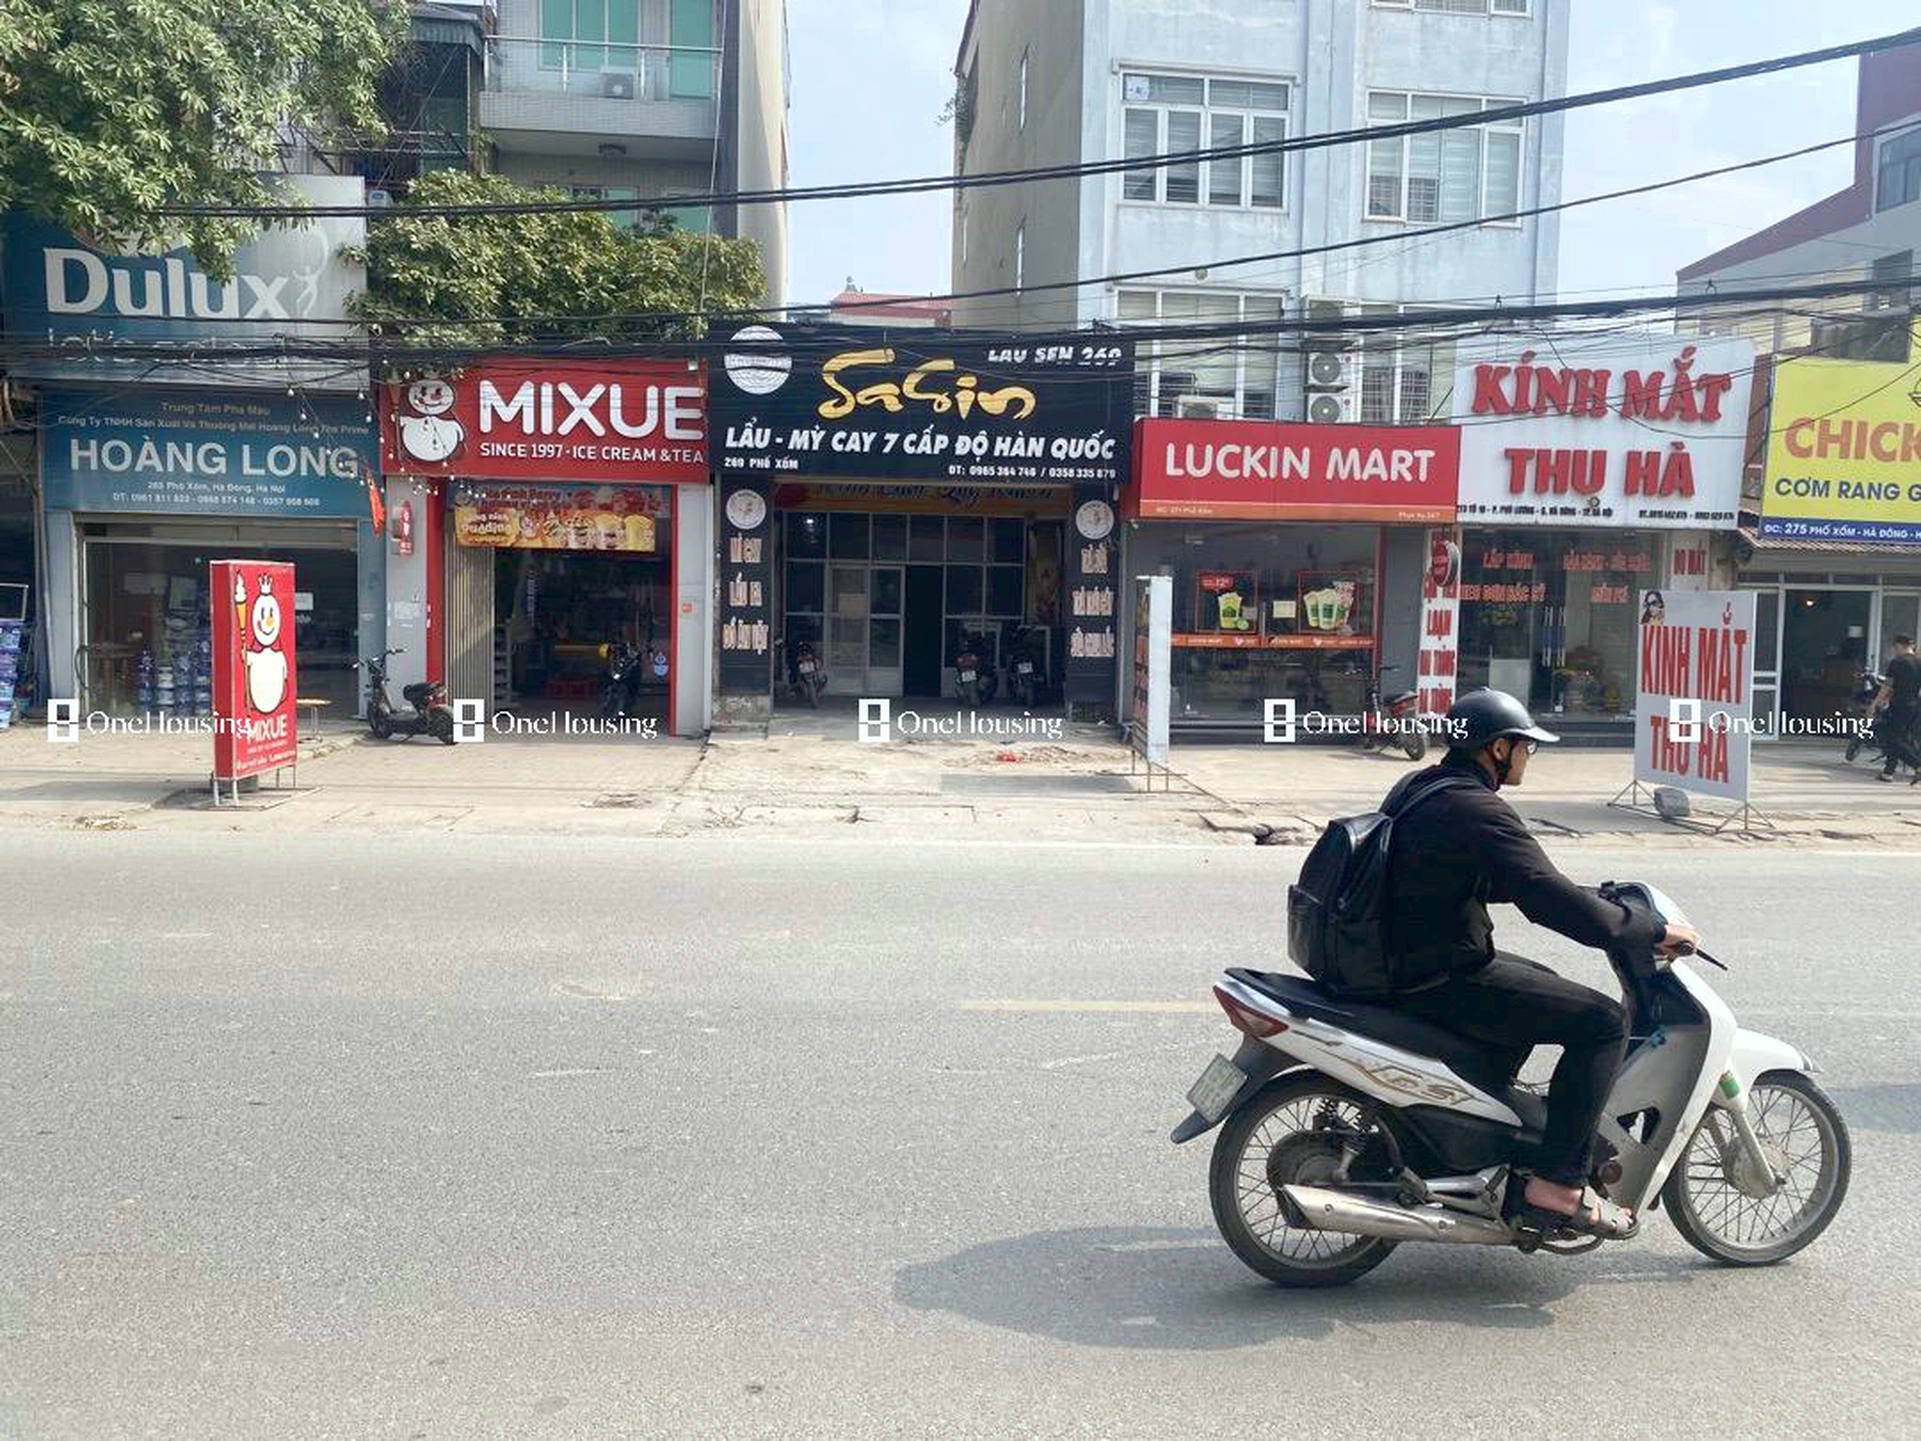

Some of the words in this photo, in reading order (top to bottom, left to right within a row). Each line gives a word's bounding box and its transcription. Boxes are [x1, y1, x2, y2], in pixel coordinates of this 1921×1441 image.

[44, 247, 290, 318] Dulux
[1471, 350, 1610, 417] KÍNH
[1620, 345, 1732, 423] MẮT
[479, 379, 704, 440] MIXUE
[70, 435, 227, 474] HOÀNG
[242, 444, 358, 478] LONG
[480, 442, 526, 457] SINCE
[531, 444, 562, 458] 1997
[573, 446, 596, 460] ICE
[602, 446, 655, 462] CREAM
[725, 416, 771, 448] LẨU
[788, 424, 826, 450] MỲ
[831, 431, 876, 452] CAY
[882, 433, 899, 453] 7
[903, 424, 949, 454] CẤP
[955, 430, 988, 461] ĐỘ
[994, 430, 1045, 458] HÀN
[1050, 429, 1116, 460] QUỐC
[1166, 443, 1309, 480] LUCKIN
[1326, 447, 1435, 483] MART
[1505, 447, 1606, 495] THU
[1624, 441, 1695, 497] HÀ
[1774, 476, 1830, 498] CƠM
[1838, 481, 1901, 501] RANG
[1784, 522, 1807, 534] 275
[247, 714, 288, 744] MIXUE
